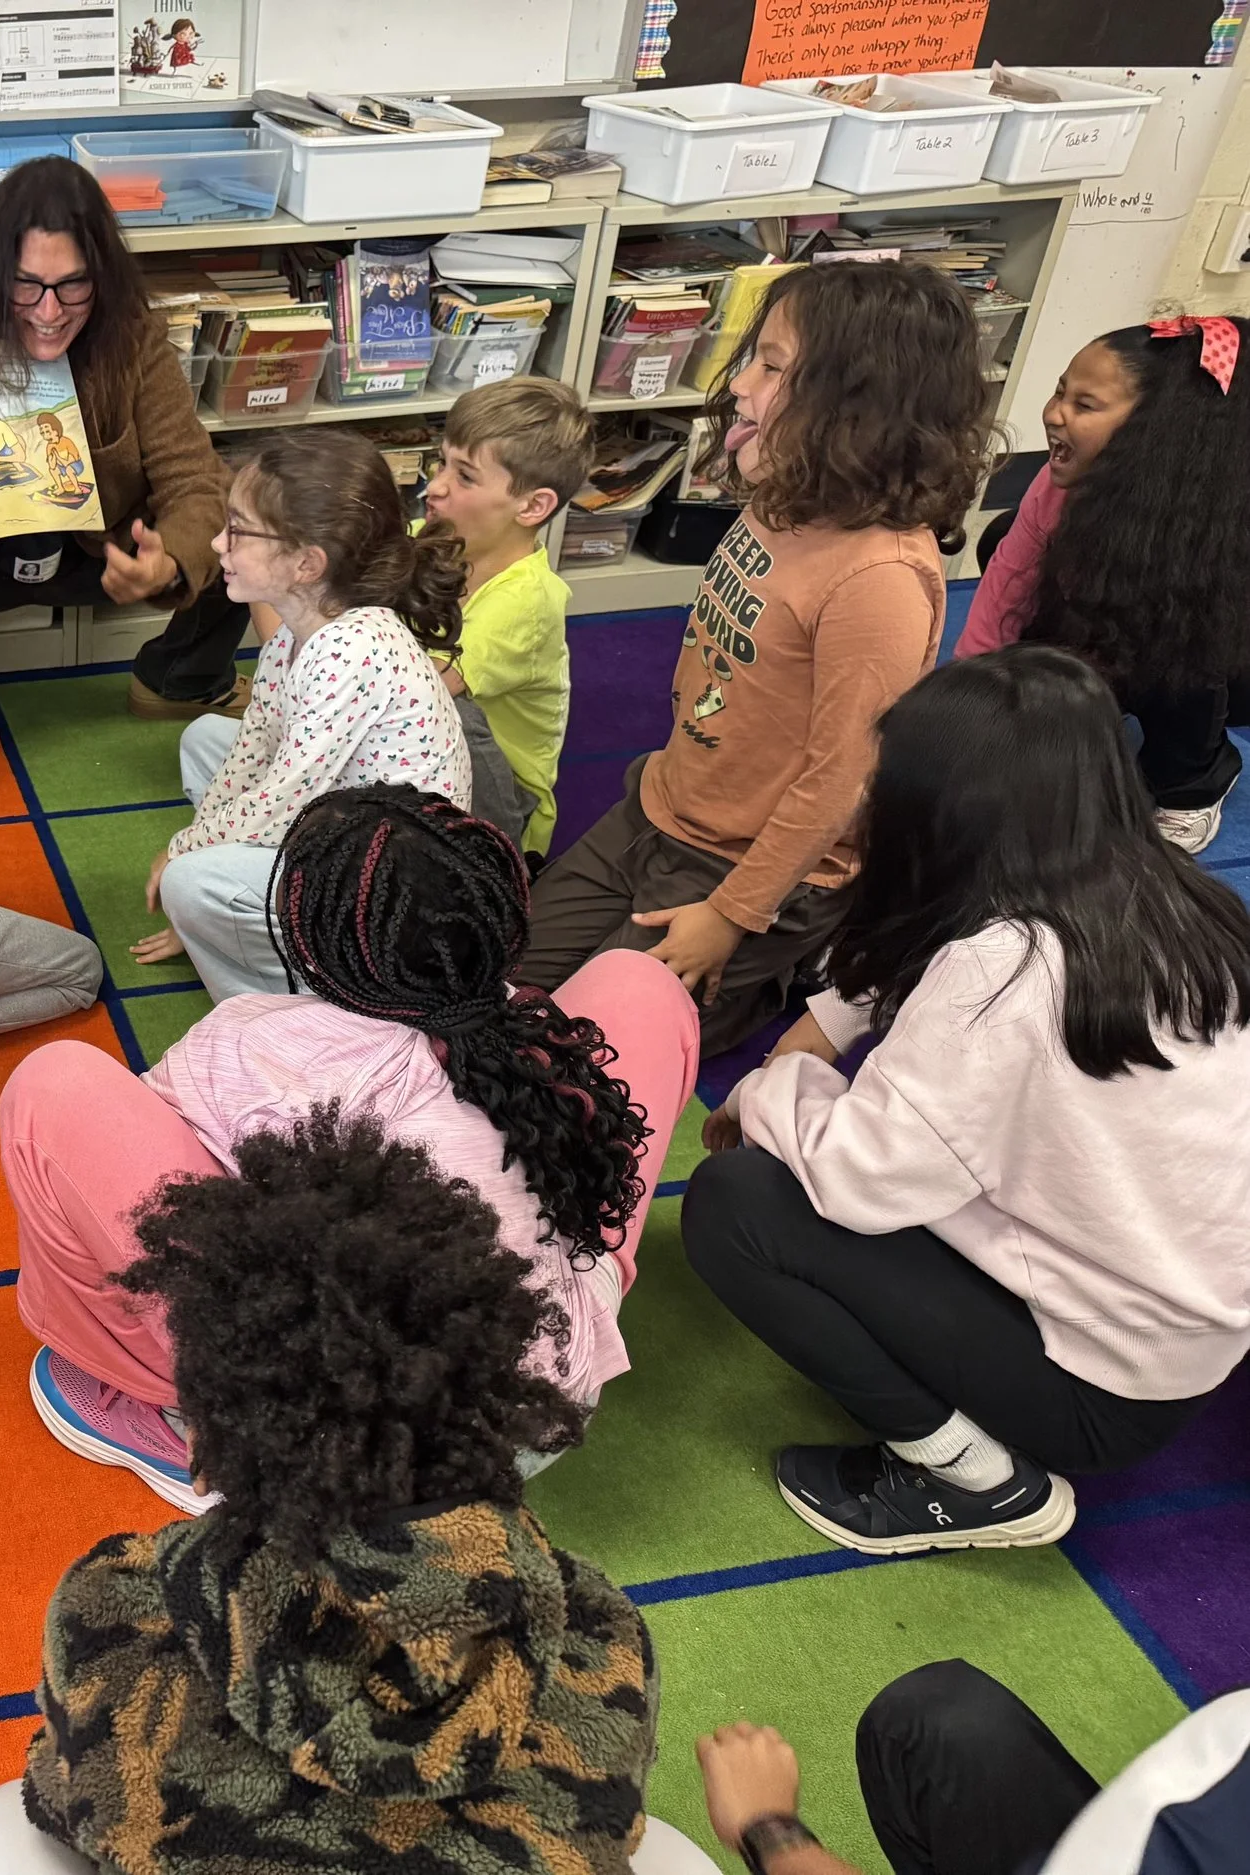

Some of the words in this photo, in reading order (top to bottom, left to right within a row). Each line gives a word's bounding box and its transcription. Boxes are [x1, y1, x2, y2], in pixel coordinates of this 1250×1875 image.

[765, 0, 803, 20] Good
[809, 0, 897, 21] sportsmanship
[771, 21, 795, 39] It's
[801, 21, 836, 39] always
[840, 17, 886, 40] pleasant
[892, 12, 922, 27] when
[927, 15, 947, 31] you
[949, 9, 971, 28] spot
[757, 42, 795, 67] There's
[801, 43, 830, 63] only
[832, 45, 855, 57] one
[861, 39, 910, 57] unhappy
[822, 64, 835, 77] to
[841, 62, 862, 75] lose
[867, 59, 879, 71] to
[882, 58, 912, 72] prove
[947, 49, 964, 70] got
[149, 82, 171, 90] ASHLEY
[916, 137, 941, 150] Table
[942, 136, 952, 148] 2
[1066, 132, 1089, 147] Table
[1091, 129, 1100, 142] 3
[1083, 186, 1117, 208] Whole
[1120, 192, 1140, 208] and
[646, 311, 676, 320] Utterly
[720, 518, 774, 581] KEEP
[703, 545, 767, 632] OVING
[695, 585, 757, 665] OUND
